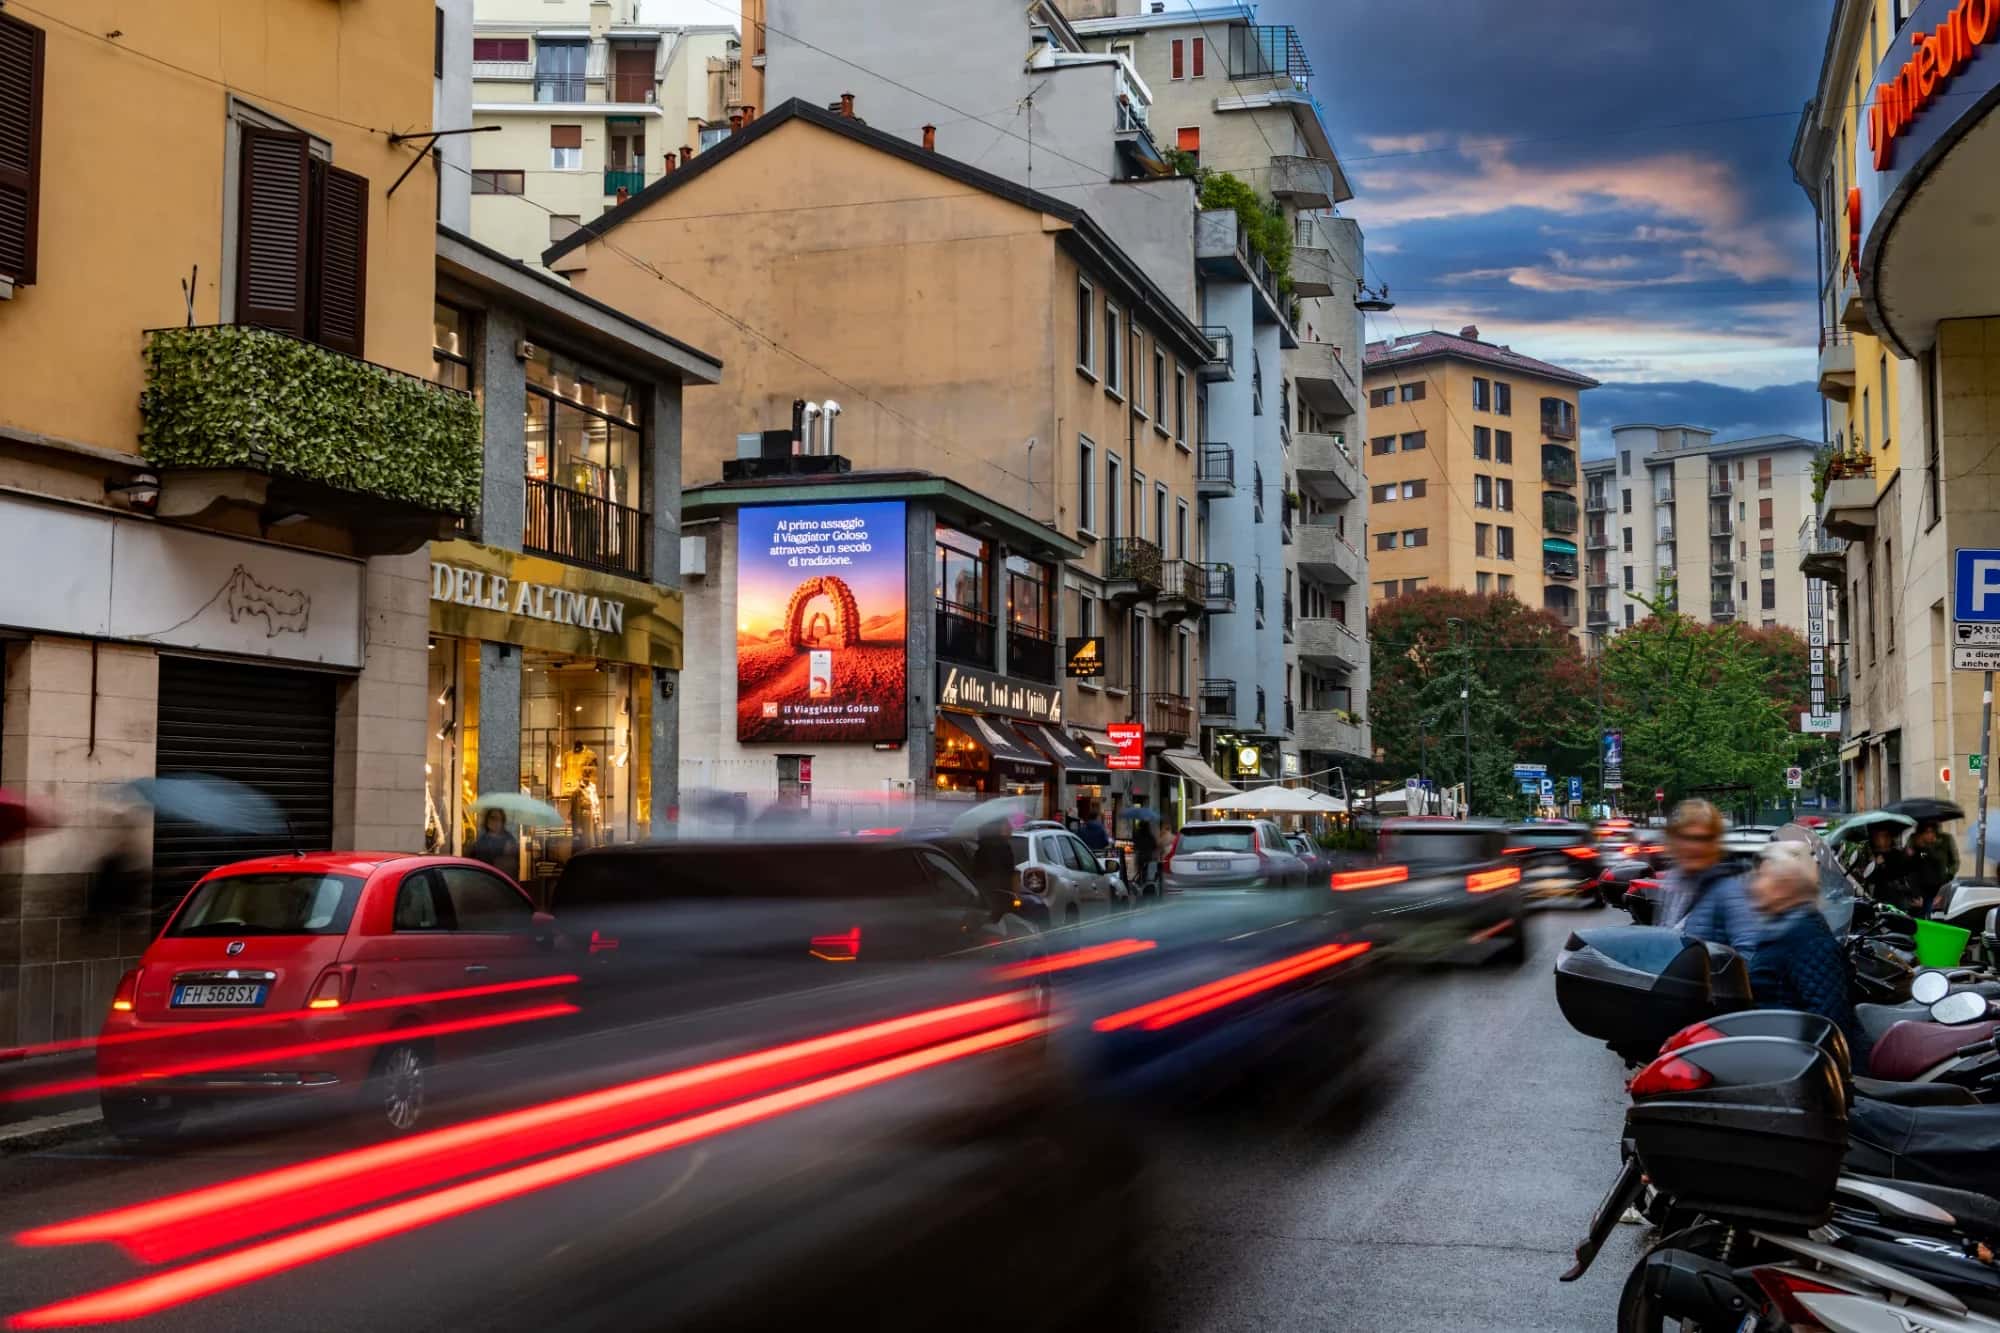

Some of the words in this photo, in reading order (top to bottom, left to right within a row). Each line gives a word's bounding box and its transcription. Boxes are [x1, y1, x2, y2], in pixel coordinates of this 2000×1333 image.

[777, 520, 787, 531] Al
[789, 519, 819, 532] primo
[821, 517, 865, 530] assaggio
[781, 532, 831, 544] Viaggiator
[832, 531, 868, 541] Goloso
[769, 544, 820, 555] attraversò
[822, 544, 836, 553] un
[837, 542, 872, 552] secolo
[788, 556, 798, 567] di
[800, 555, 853, 567] tradizione.
[430, 562, 509, 612] DELE
[511, 581, 624, 634] ALTMAN
[794, 705, 843, 715] Viaggiator
[846, 704, 879, 713] Goloso
[1541, 780, 1553, 794] P
[1572, 781, 1579, 792] P
[184, 986, 203, 1002] FH
[207, 986, 256, 1002] 568SX
